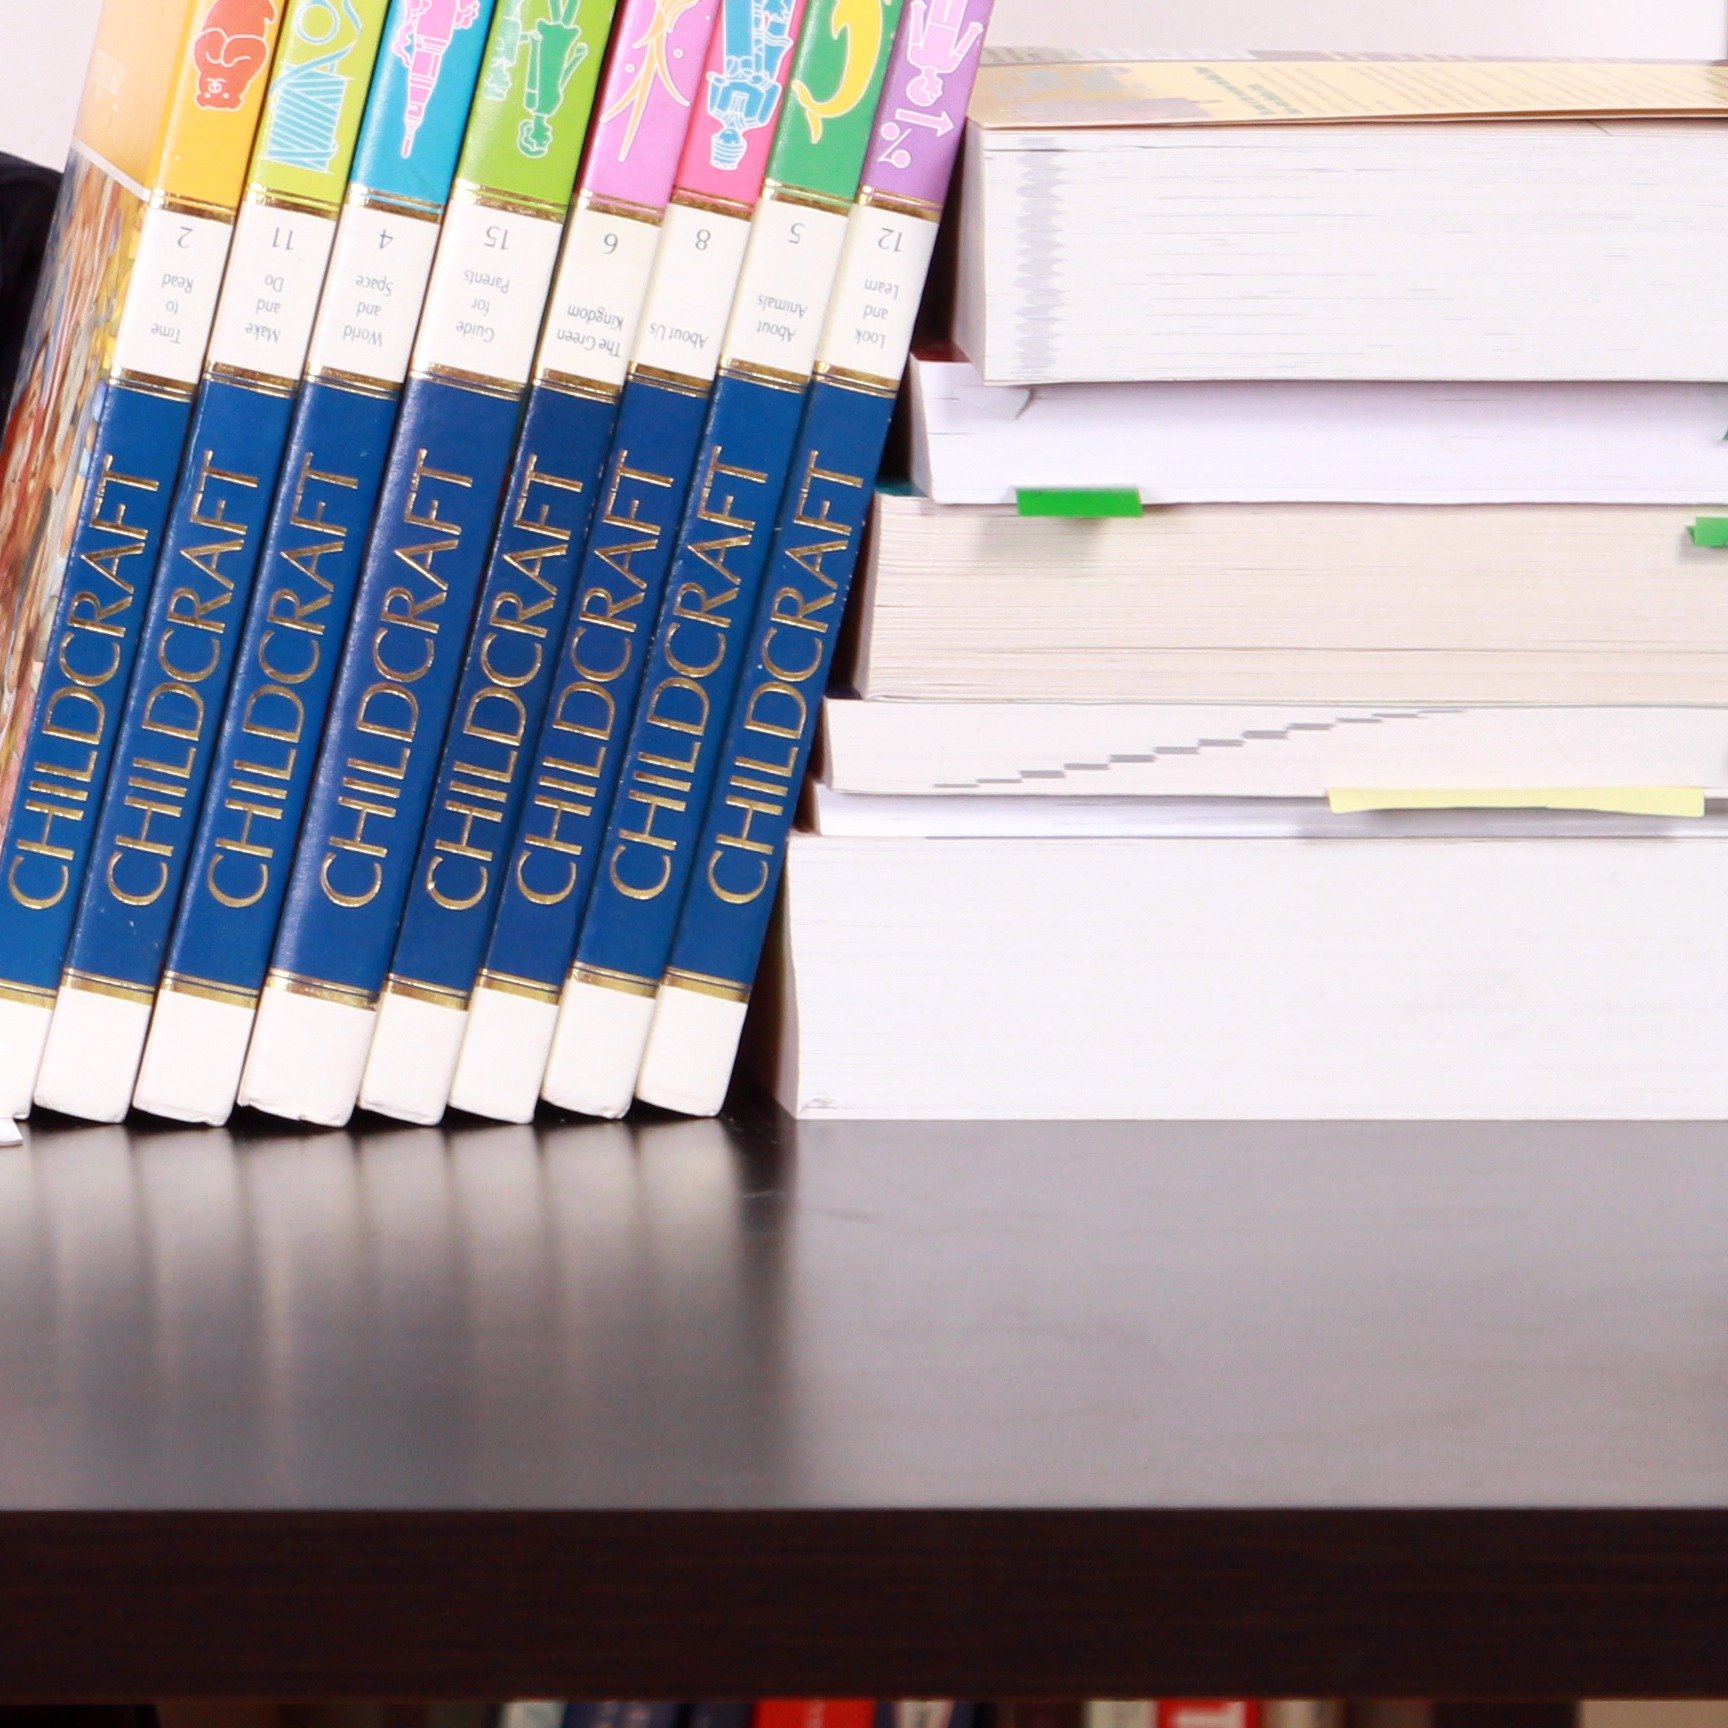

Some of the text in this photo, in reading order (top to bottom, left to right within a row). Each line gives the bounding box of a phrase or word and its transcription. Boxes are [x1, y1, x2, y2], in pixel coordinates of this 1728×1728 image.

[178, 226, 193, 249] 2
[272, 226, 294, 251] 11
[379, 228, 394, 249] 4
[484, 224, 510, 250] 15
[603, 233, 618, 255] 6
[695, 229, 711, 250] 8
[789, 222, 804, 244] 5
[877, 227, 904, 253] 12
[162, 272, 193, 293] Read
[265, 273, 284, 293] Do
[355, 273, 393, 296] Space
[463, 269, 510, 293] Parents
[864, 278, 899, 299] Learn
[165, 299, 179, 316] to
[256, 298, 281, 317] and
[356, 300, 381, 318] and
[472, 297, 491, 316] for
[567, 304, 624, 331] Kingdom
[757, 294, 808, 318] Animals
[863, 304, 888, 321] and
[151, 323, 181, 344] Time
[244, 321, 281, 343] Make
[343, 324, 382, 347] World
[455, 320, 495, 342] Guide
[650, 323, 708, 349] About Us
[756, 320, 795, 342] About
[855, 328, 886, 349] Look
[557, 328, 621, 358] The Green
[7, 453, 161, 910] CHILDCRAFT
[106, 449, 259, 908] CHILDCRAFT
[206, 452, 360, 908] CHILDCRAFT
[321, 449, 475, 908] CHILDCRAFT
[425, 455, 585, 911] CHILDCRAFT
[515, 449, 673, 906] CHILDCRAFT
[609, 447, 768, 902] CHILDCRAFT
[707, 448, 866, 906] CHILDCRAFT
